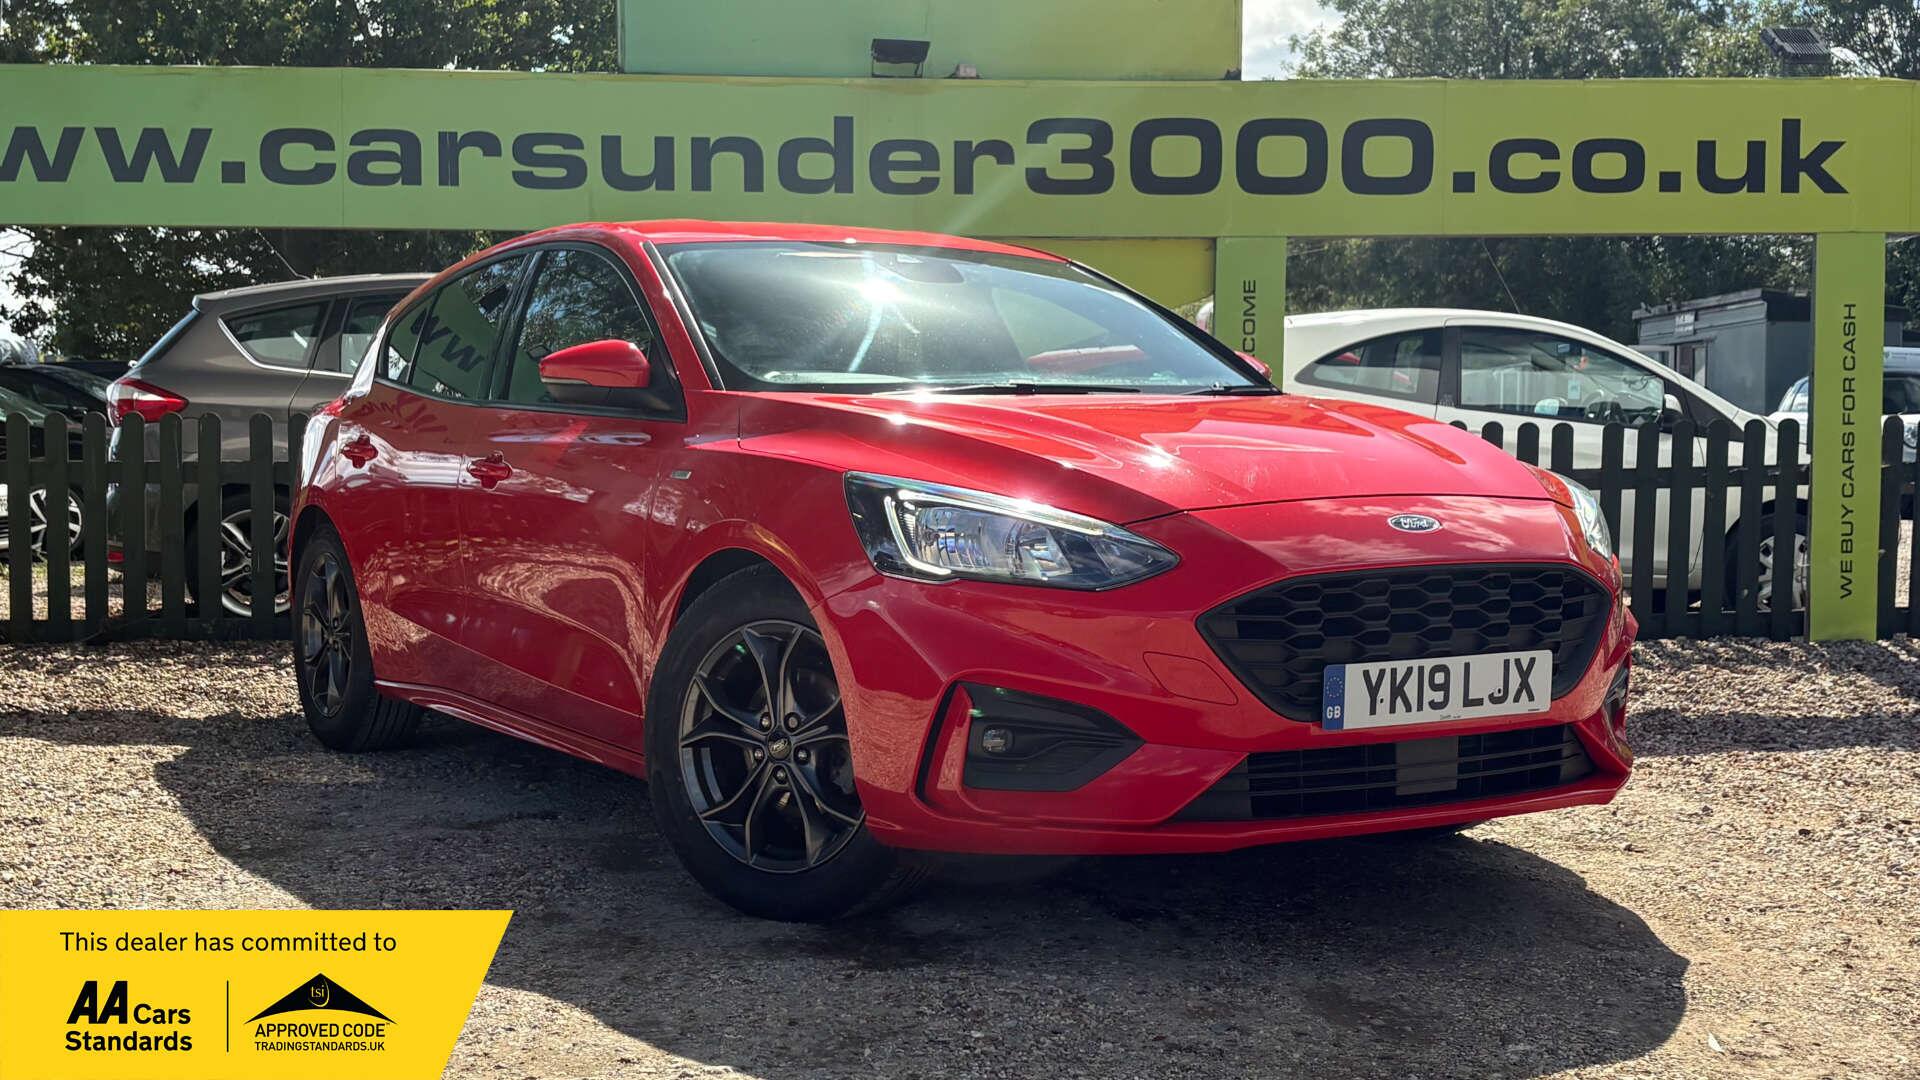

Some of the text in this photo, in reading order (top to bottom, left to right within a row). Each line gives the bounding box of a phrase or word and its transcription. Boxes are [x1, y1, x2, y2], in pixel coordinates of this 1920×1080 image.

[1242, 280, 1256, 356] COME
[1840, 303, 1856, 600] WE BUY CARS FOR CASH
[1326, 705, 1342, 720] GB
[1362, 656, 1537, 716] YK19 LJX
